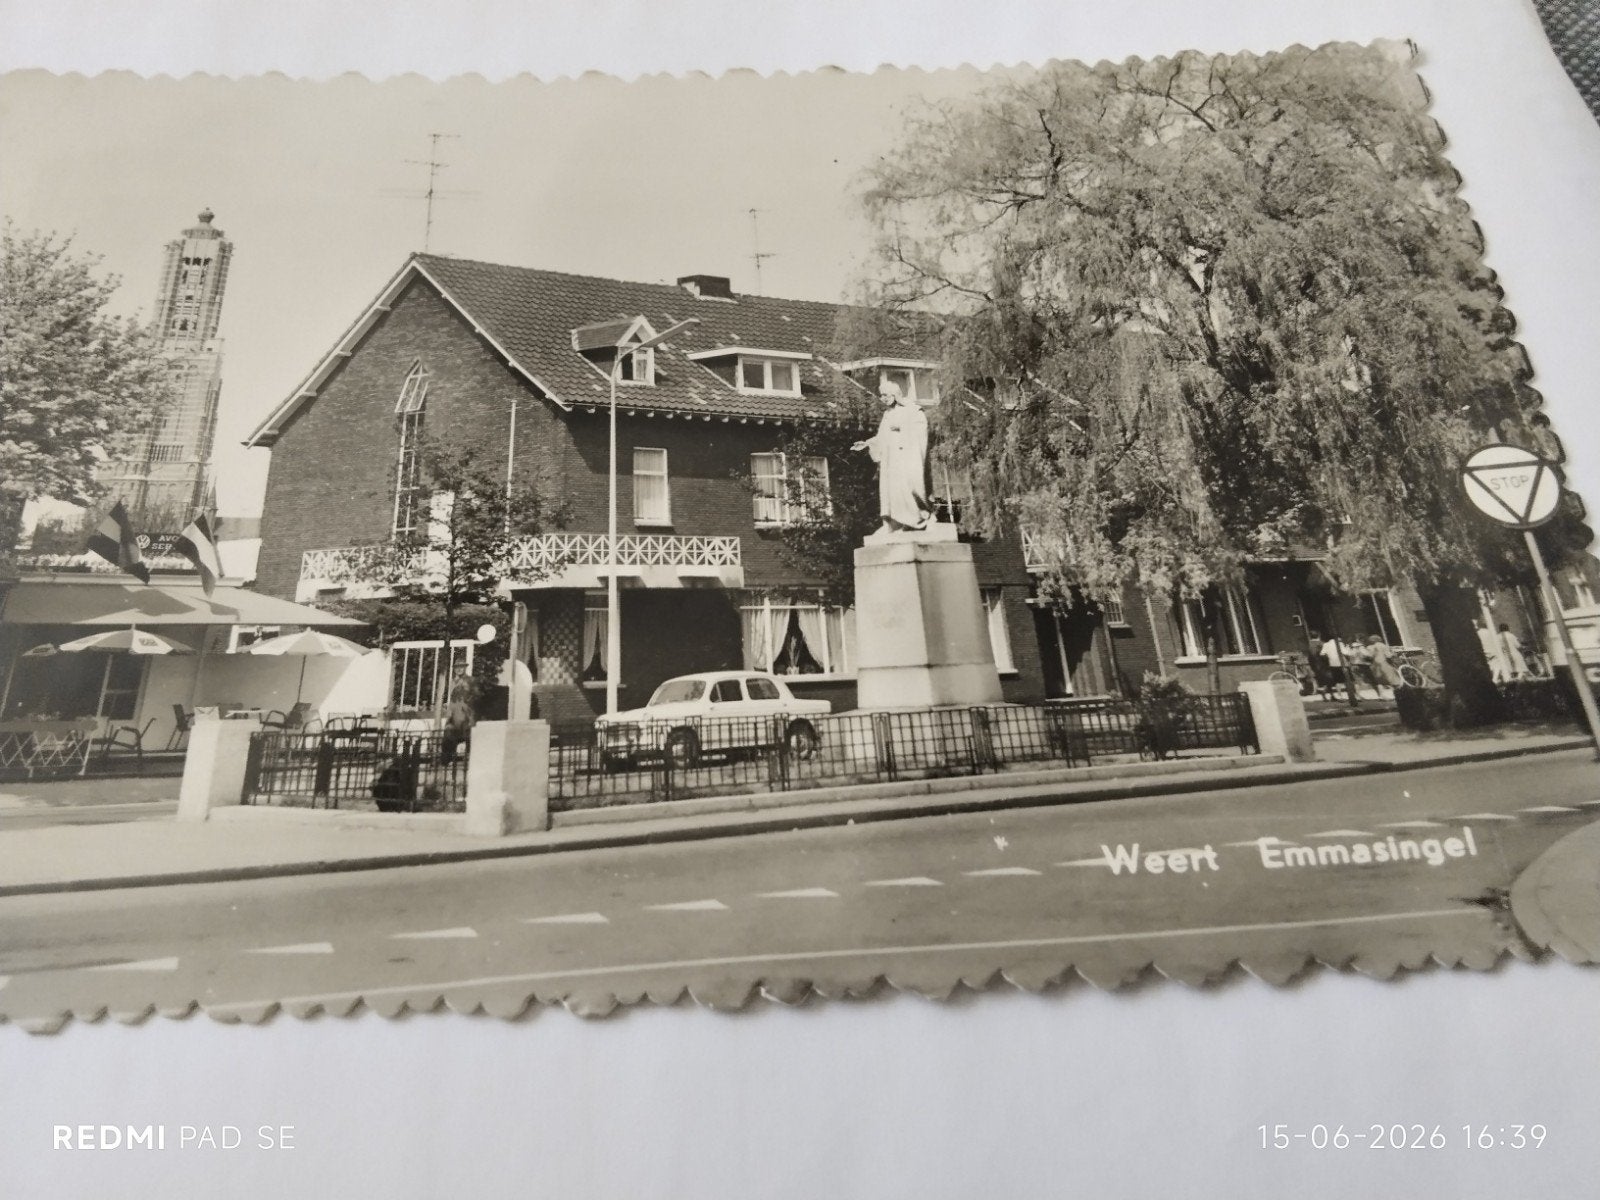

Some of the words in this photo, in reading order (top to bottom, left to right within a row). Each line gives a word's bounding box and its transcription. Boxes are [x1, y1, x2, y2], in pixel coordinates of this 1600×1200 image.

[1489, 474, 1529, 491] STOP
[1101, 842, 1220, 876] Weert
[1258, 826, 1478, 869] Emmasingel
